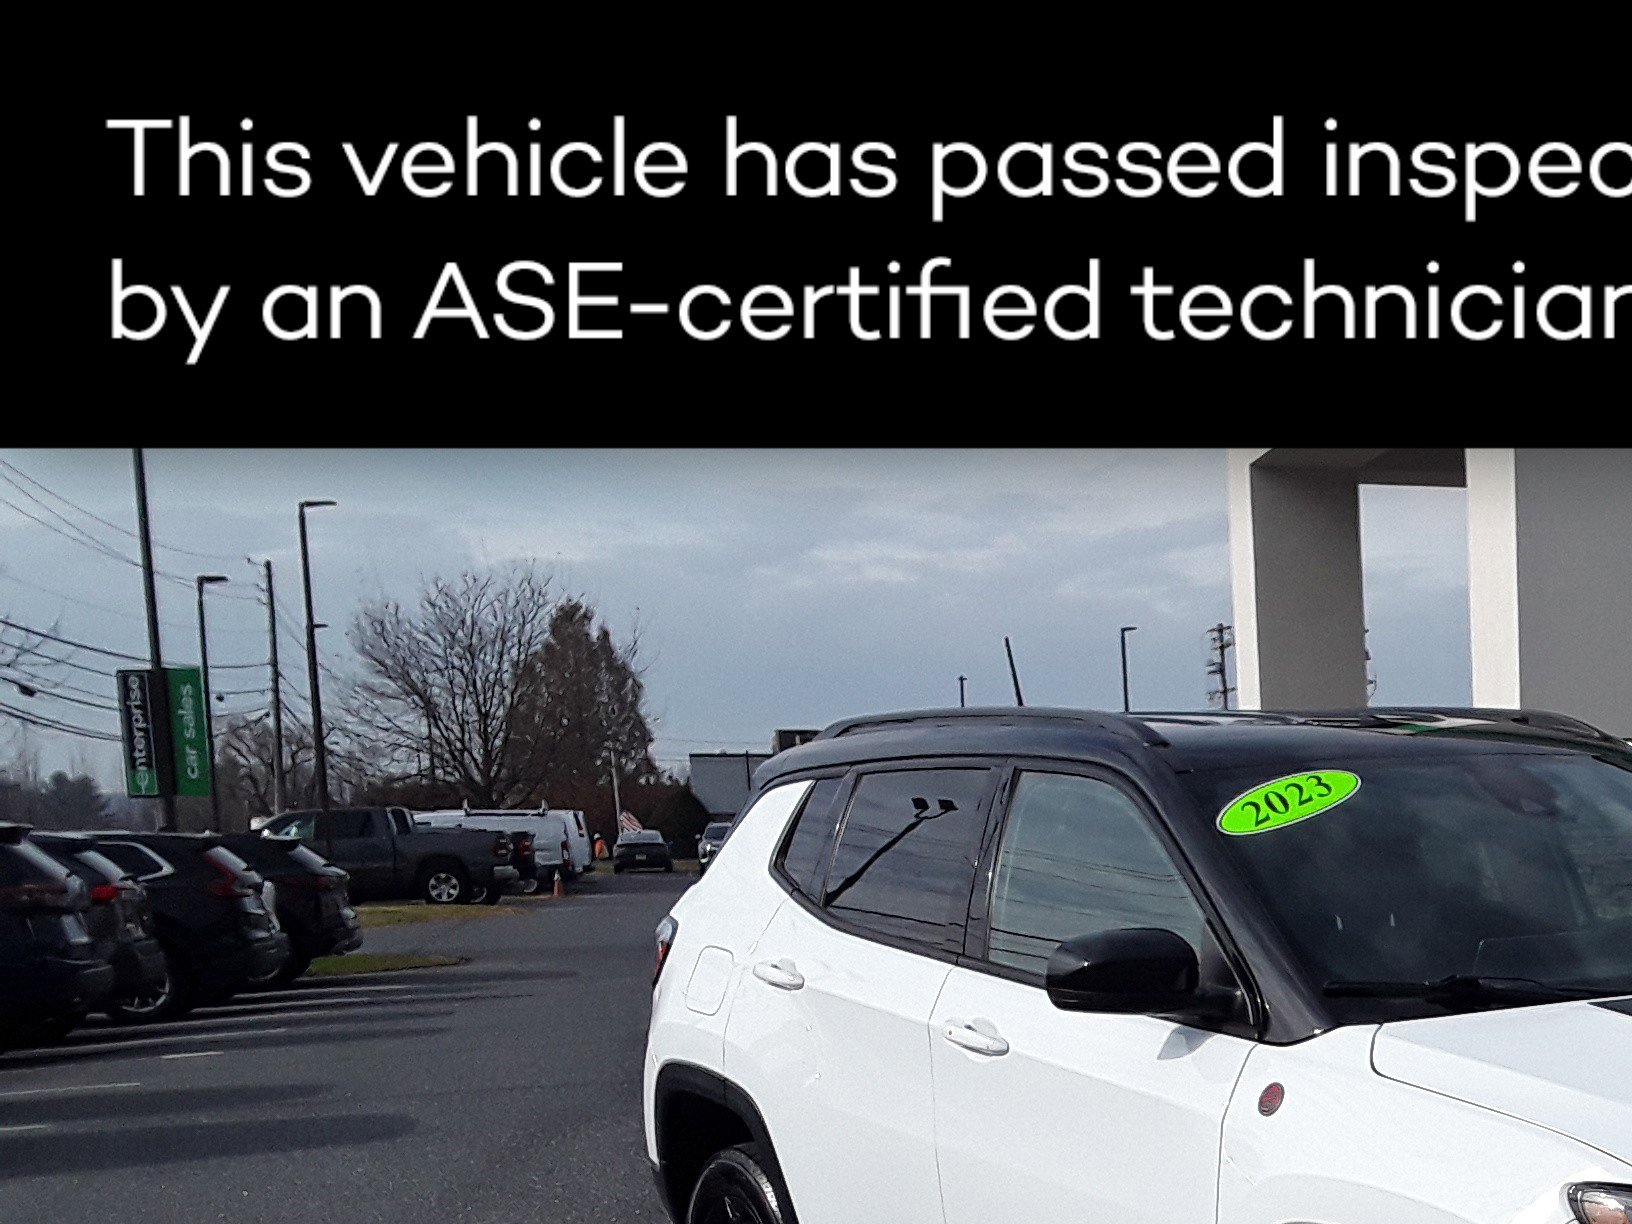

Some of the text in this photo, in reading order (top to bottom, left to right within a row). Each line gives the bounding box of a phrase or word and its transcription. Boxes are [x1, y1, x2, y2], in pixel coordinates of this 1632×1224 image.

[177, 684, 200, 779] car sales
[1241, 774, 1332, 828] 2023
